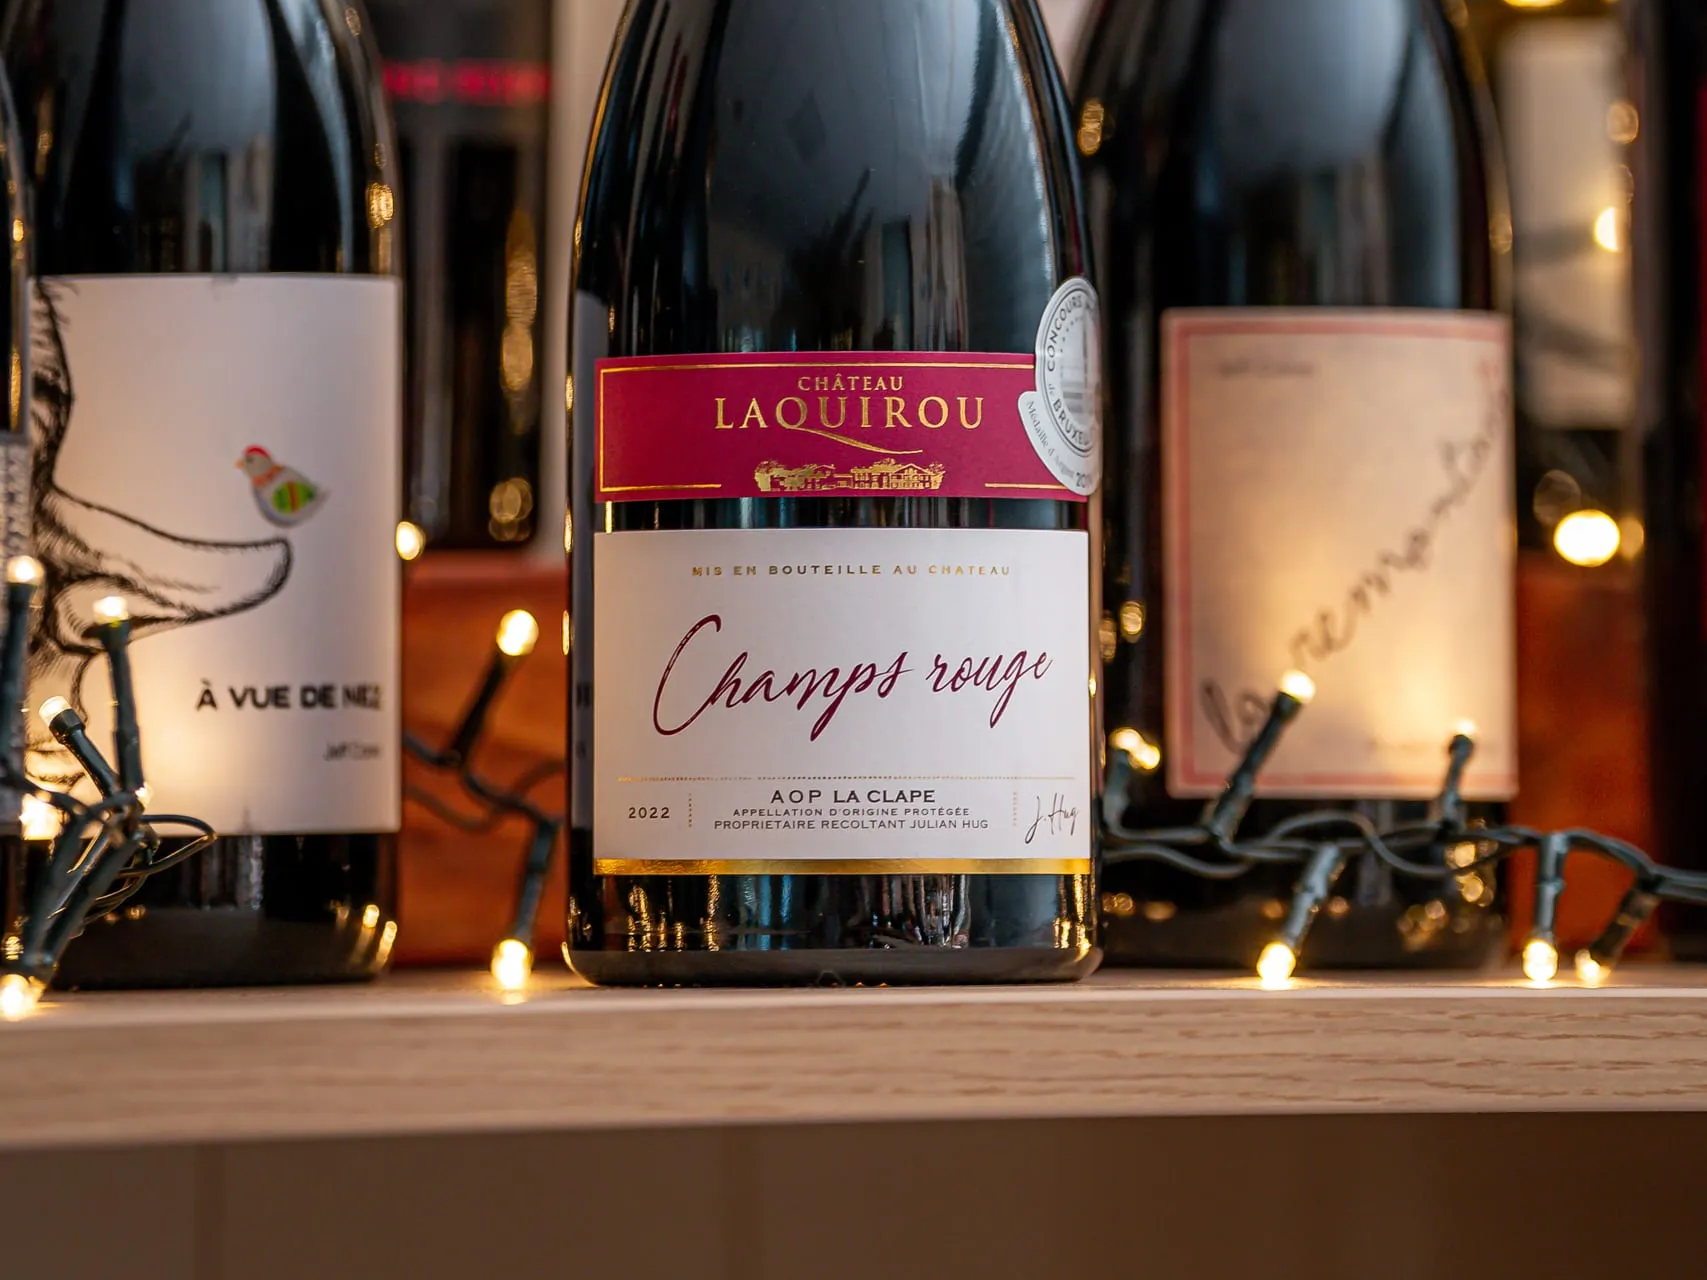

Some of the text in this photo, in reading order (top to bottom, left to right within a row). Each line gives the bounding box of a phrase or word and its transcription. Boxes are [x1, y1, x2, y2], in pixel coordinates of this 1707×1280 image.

[1047, 295, 1082, 372] CONCOURS
[797, 372, 904, 392] CHÂTEAU
[714, 395, 984, 454] LAQUIROU
[1053, 398, 1089, 446] BRUXE
[692, 565, 1012, 577] MIS EN BOUTEILLE AU CHATEAU
[652, 614, 1054, 742] Champs rouge
[228, 684, 291, 711] VUE
[300, 684, 337, 710] DE
[833, 789, 862, 803] LA
[866, 789, 936, 803] CLAPE
[628, 806, 671, 819] 2022
[732, 806, 971, 817] APPELLATION D'ORIGINE PROTÉGÉE
[713, 819, 989, 830] PROPRIETAIRE RECOLTANT JULIAN HUG
